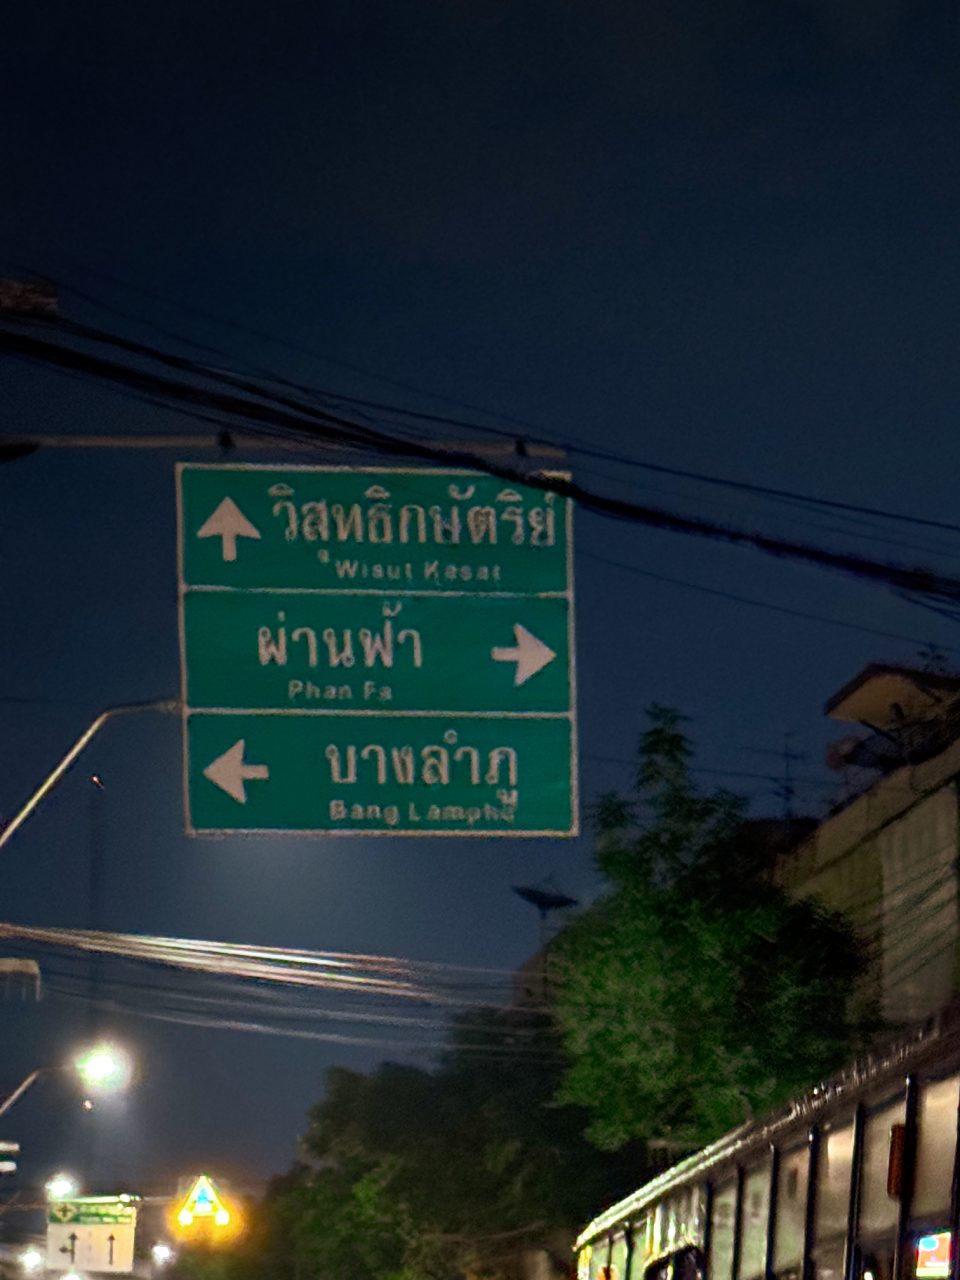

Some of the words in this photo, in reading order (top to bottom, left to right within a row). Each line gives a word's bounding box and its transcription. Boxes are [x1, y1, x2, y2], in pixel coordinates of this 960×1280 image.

[336, 559, 412, 580] Wisut
[424, 560, 502, 585] Kasat
[257, 601, 423, 668] ผ่านฟ้า
[288, 680, 353, 700] Phan
[363, 681, 394, 701] Fa
[325, 729, 519, 806] บางลำภู
[329, 800, 400, 826] Bang
[408, 802, 516, 825] Lamphu
